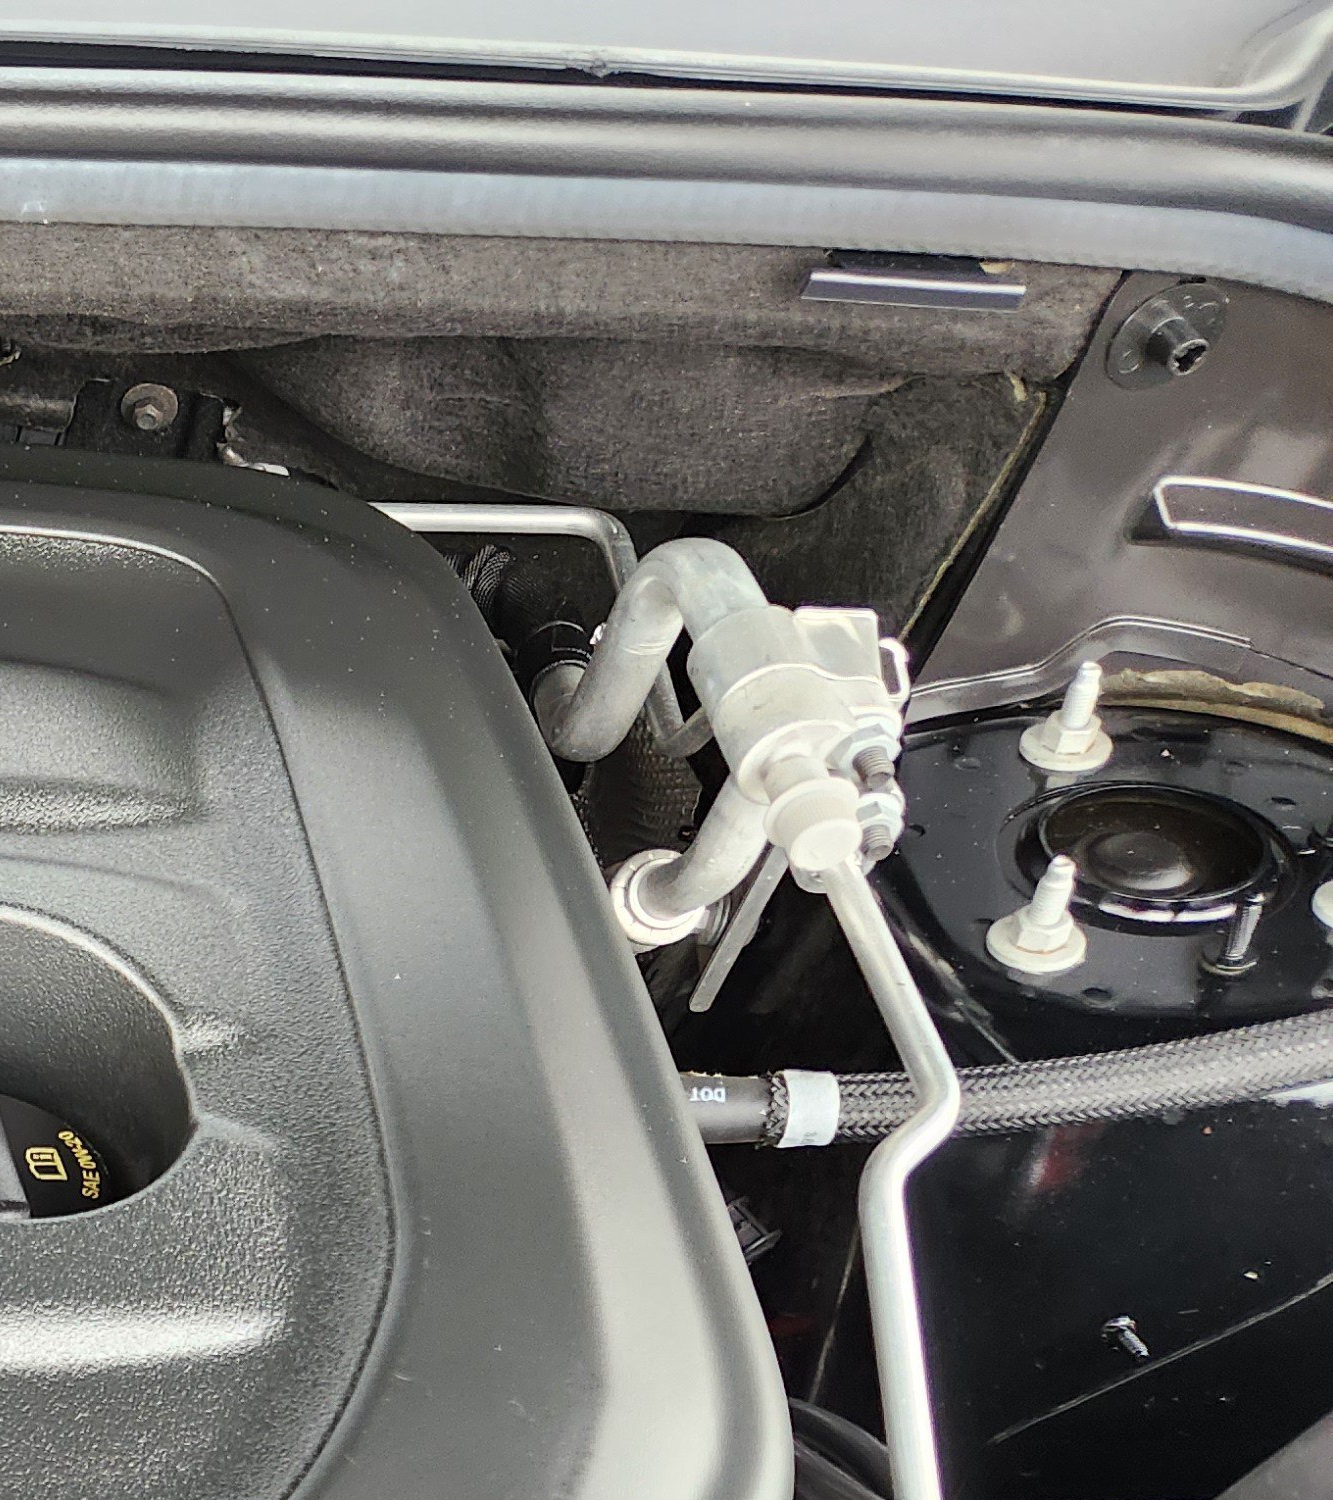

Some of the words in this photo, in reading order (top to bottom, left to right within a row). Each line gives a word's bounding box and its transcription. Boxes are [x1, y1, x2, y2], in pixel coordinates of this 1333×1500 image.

[689, 1085, 726, 1103] DOT
[58, 1130, 97, 1170] 0W-20
[81, 1169, 101, 1199] SAE
